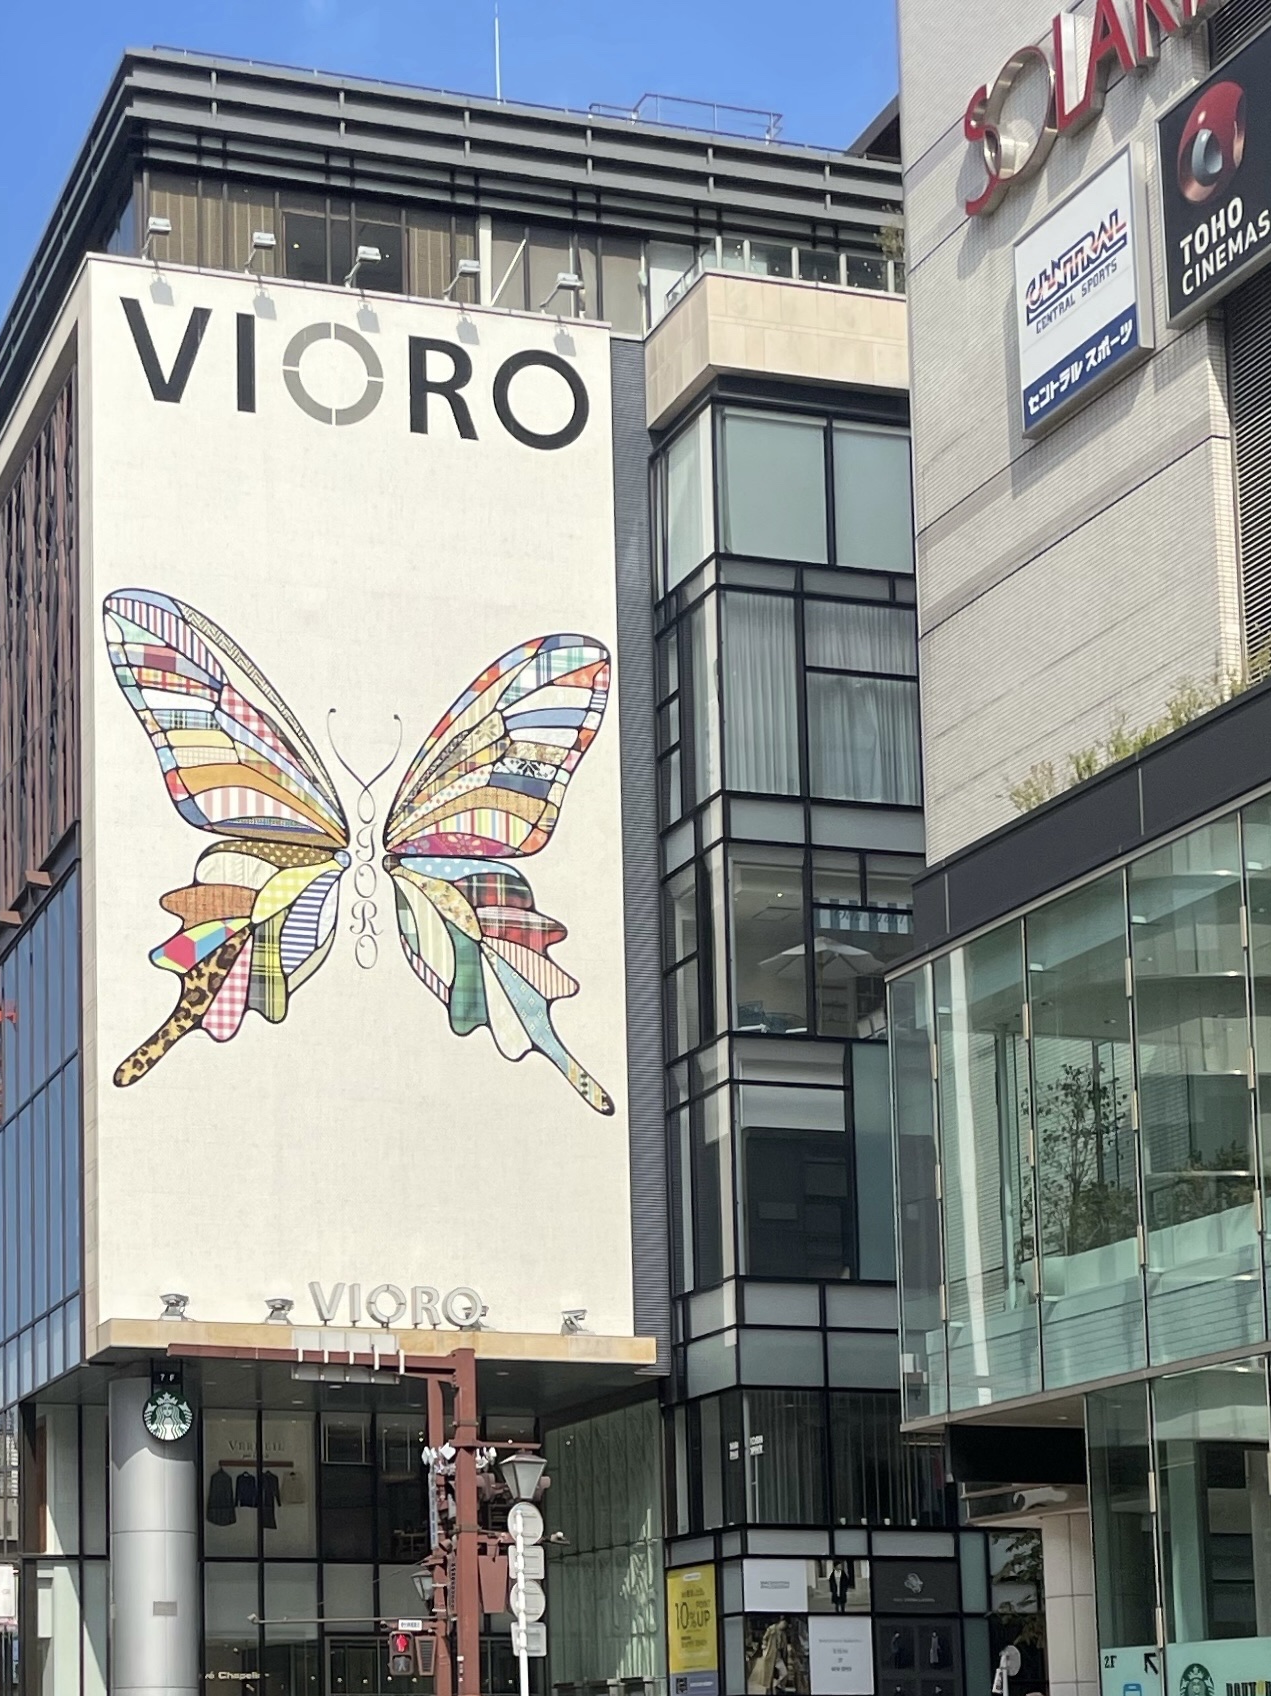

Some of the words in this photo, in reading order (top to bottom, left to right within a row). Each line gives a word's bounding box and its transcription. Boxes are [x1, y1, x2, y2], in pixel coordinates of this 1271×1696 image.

[1179, 197, 1243, 267] TOHO
[1181, 210, 1271, 296] CINEMAS
[1036, 297, 1076, 334] CENTRAL
[1081, 257, 1117, 298] SPORTS
[119, 296, 590, 451] VIORO
[1028, 360, 1083, 415] セントラル
[1086, 318, 1133, 373] スポーツ
[308, 1281, 483, 1327] VIORO
[228, 1440, 285, 1452] VEREIL
[1104, 1655, 1118, 1669] 2F
